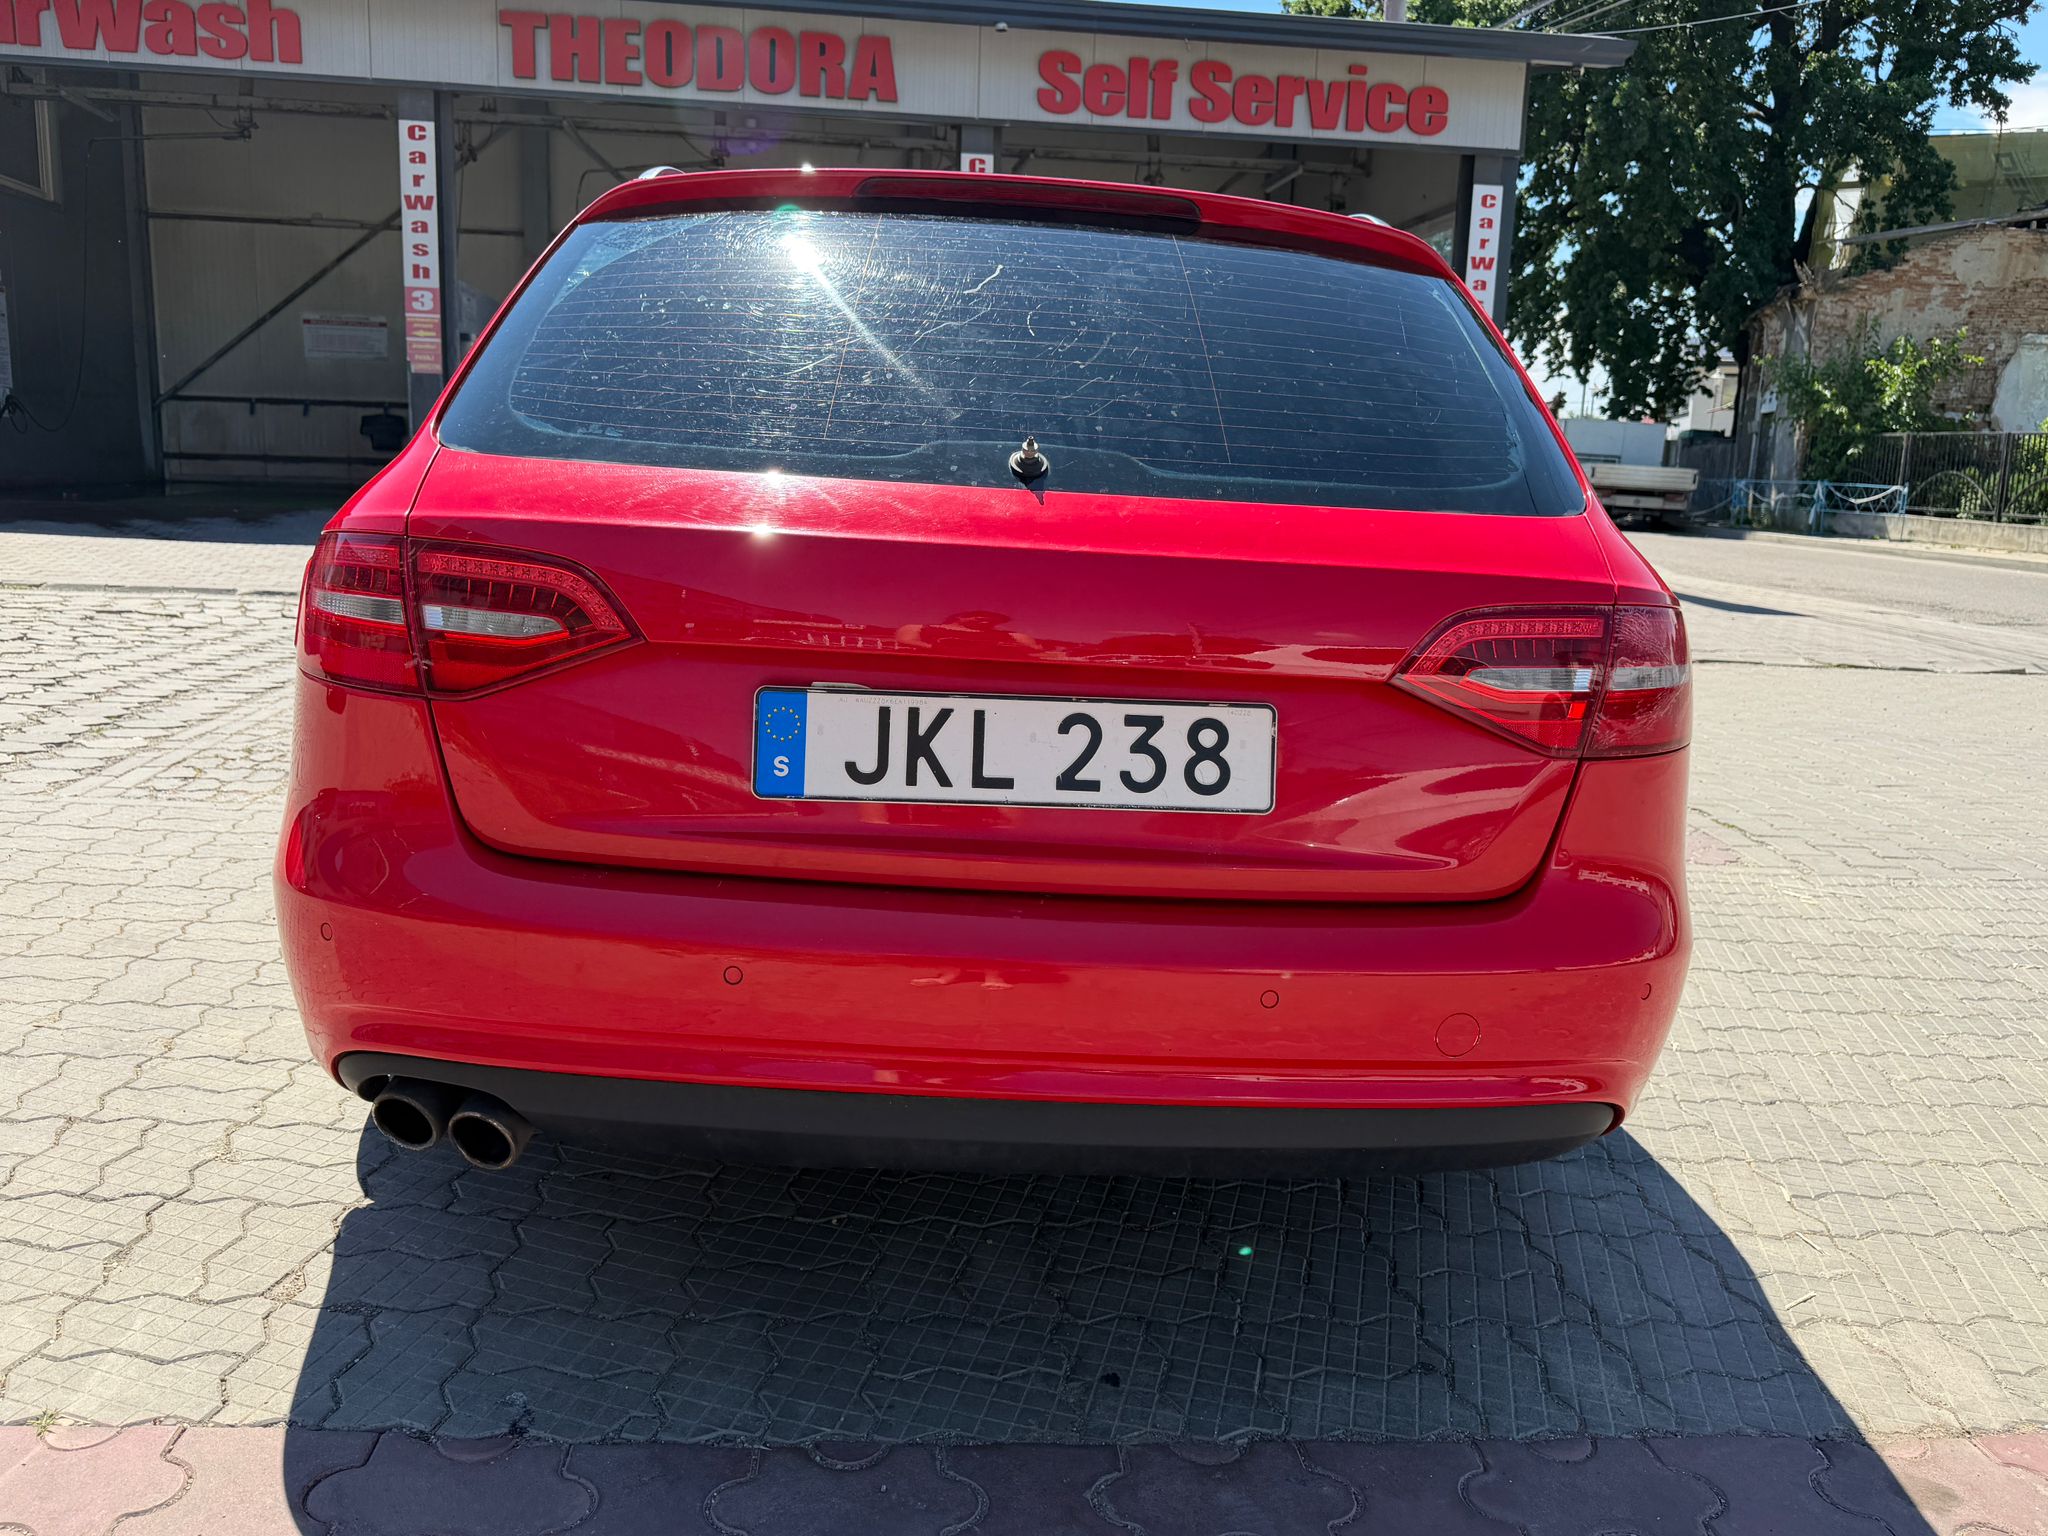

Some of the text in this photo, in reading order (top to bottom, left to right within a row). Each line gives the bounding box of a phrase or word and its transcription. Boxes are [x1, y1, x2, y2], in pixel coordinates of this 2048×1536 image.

[499, 9, 898, 103] THEODORA
[1036, 49, 1450, 137] Self Service
[1470, 194, 1497, 306] CarWa
[411, 290, 434, 311] 3
[773, 755, 790, 778] S
[844, 706, 1232, 796] JKL 238
